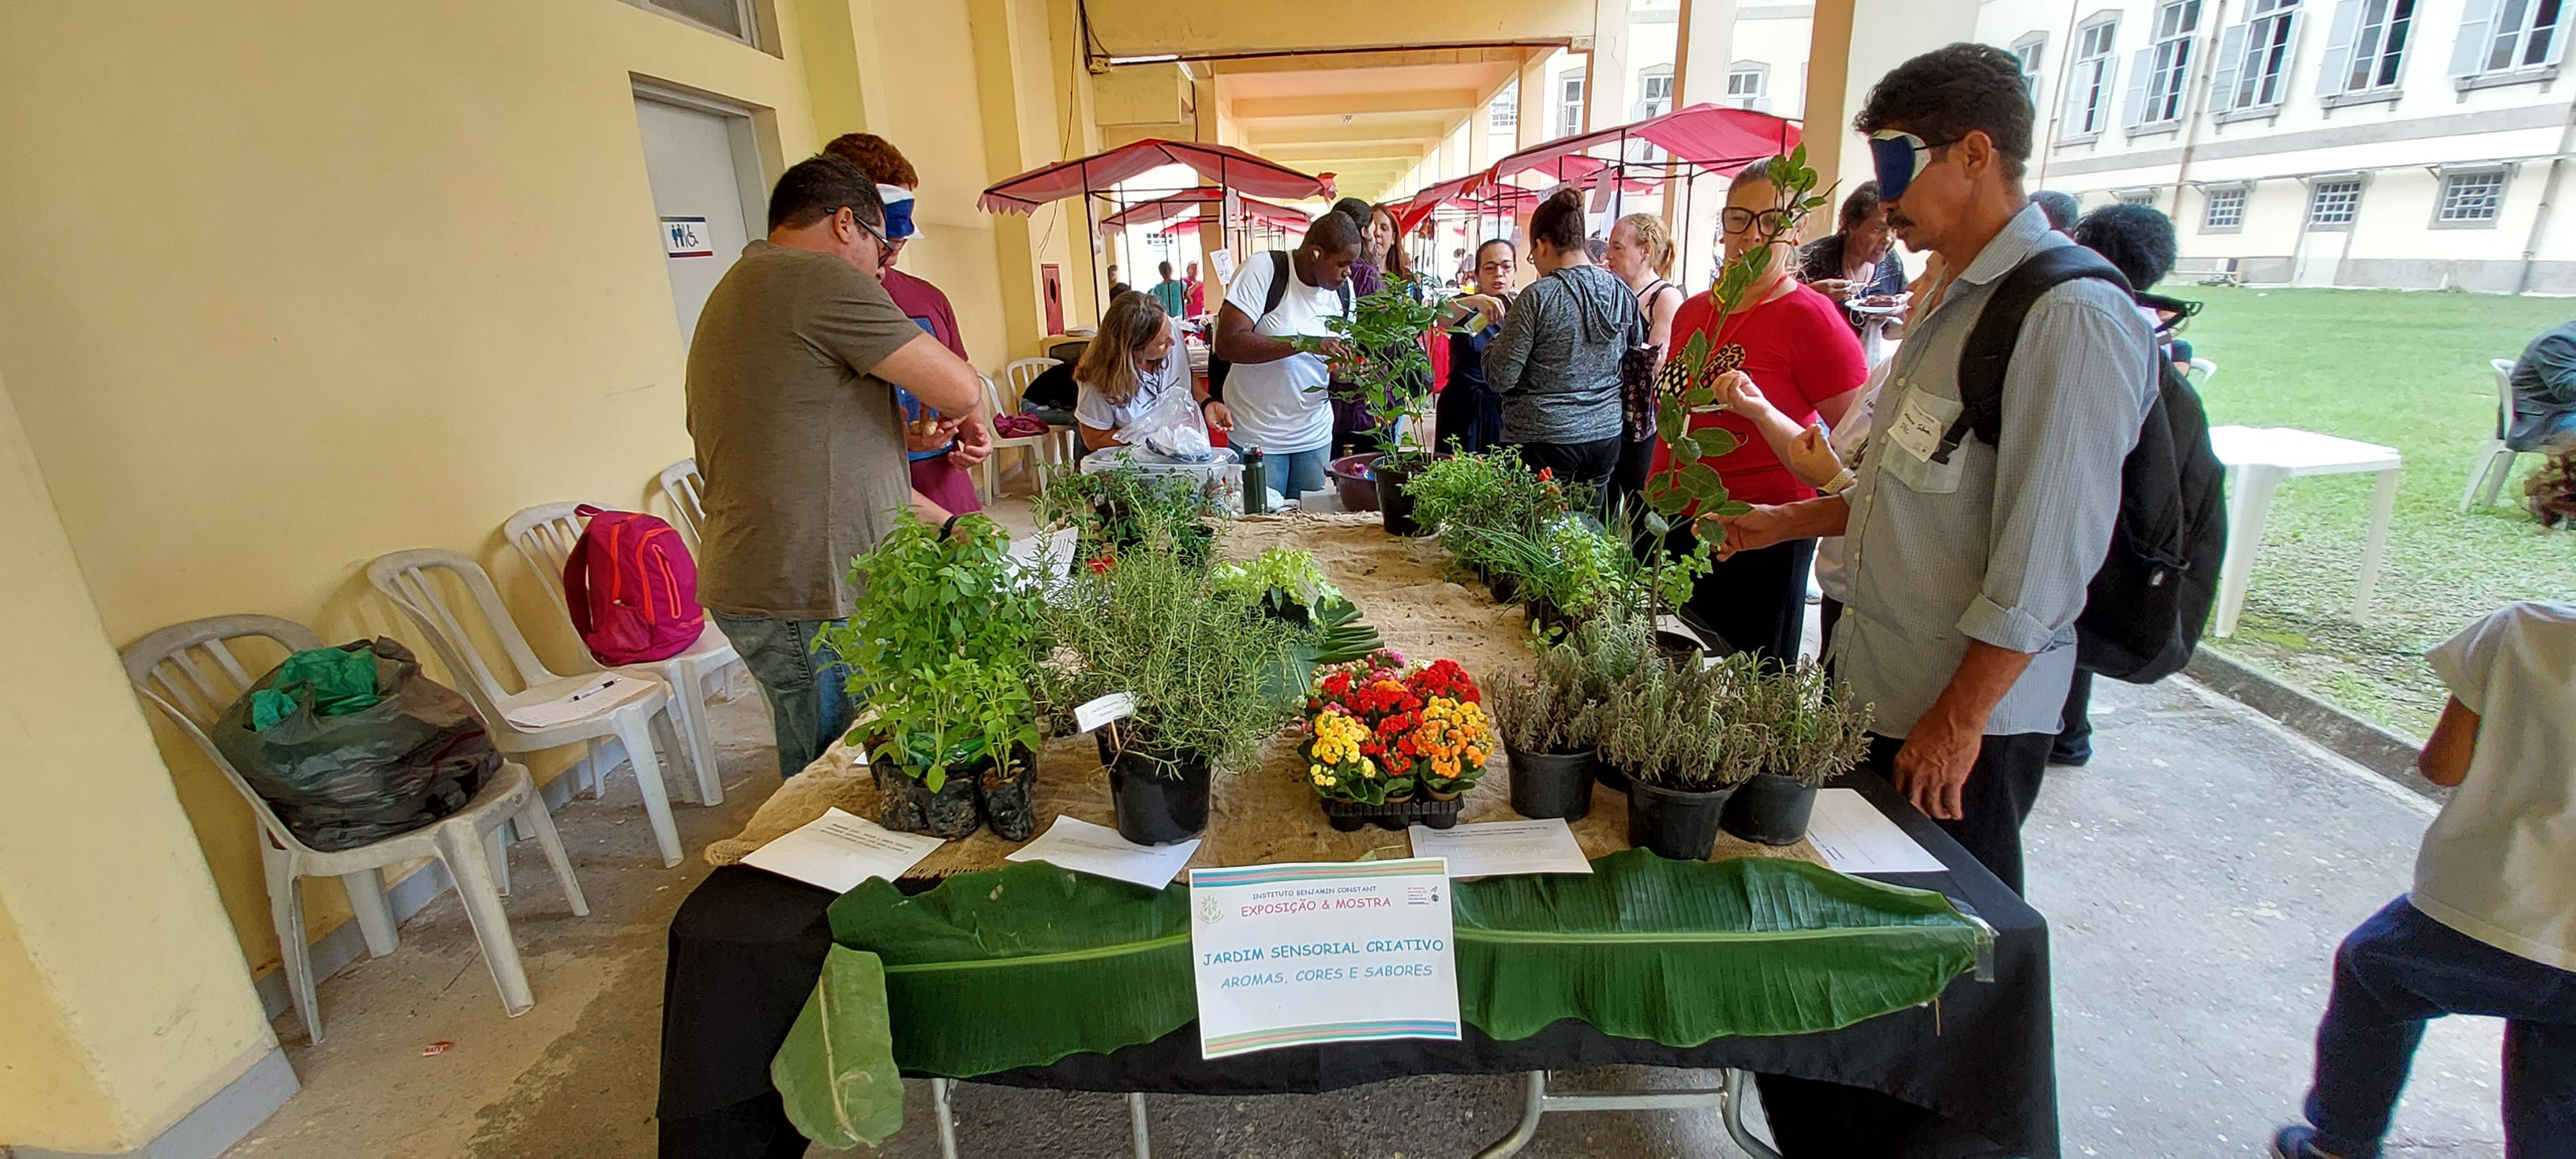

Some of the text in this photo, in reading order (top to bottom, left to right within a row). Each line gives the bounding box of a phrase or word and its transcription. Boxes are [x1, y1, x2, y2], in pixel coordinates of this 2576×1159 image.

[1252, 885, 1377, 900] INSTITUTO BENJAMIN CONSTANT
[1241, 897, 1391, 917] EXPOSIÇÃO & MOSTRA
[1203, 939, 1444, 966] JARDIM SENSORIAL CRIATIVO
[1220, 964, 1433, 989] AROMAS, CORES E SABORES
